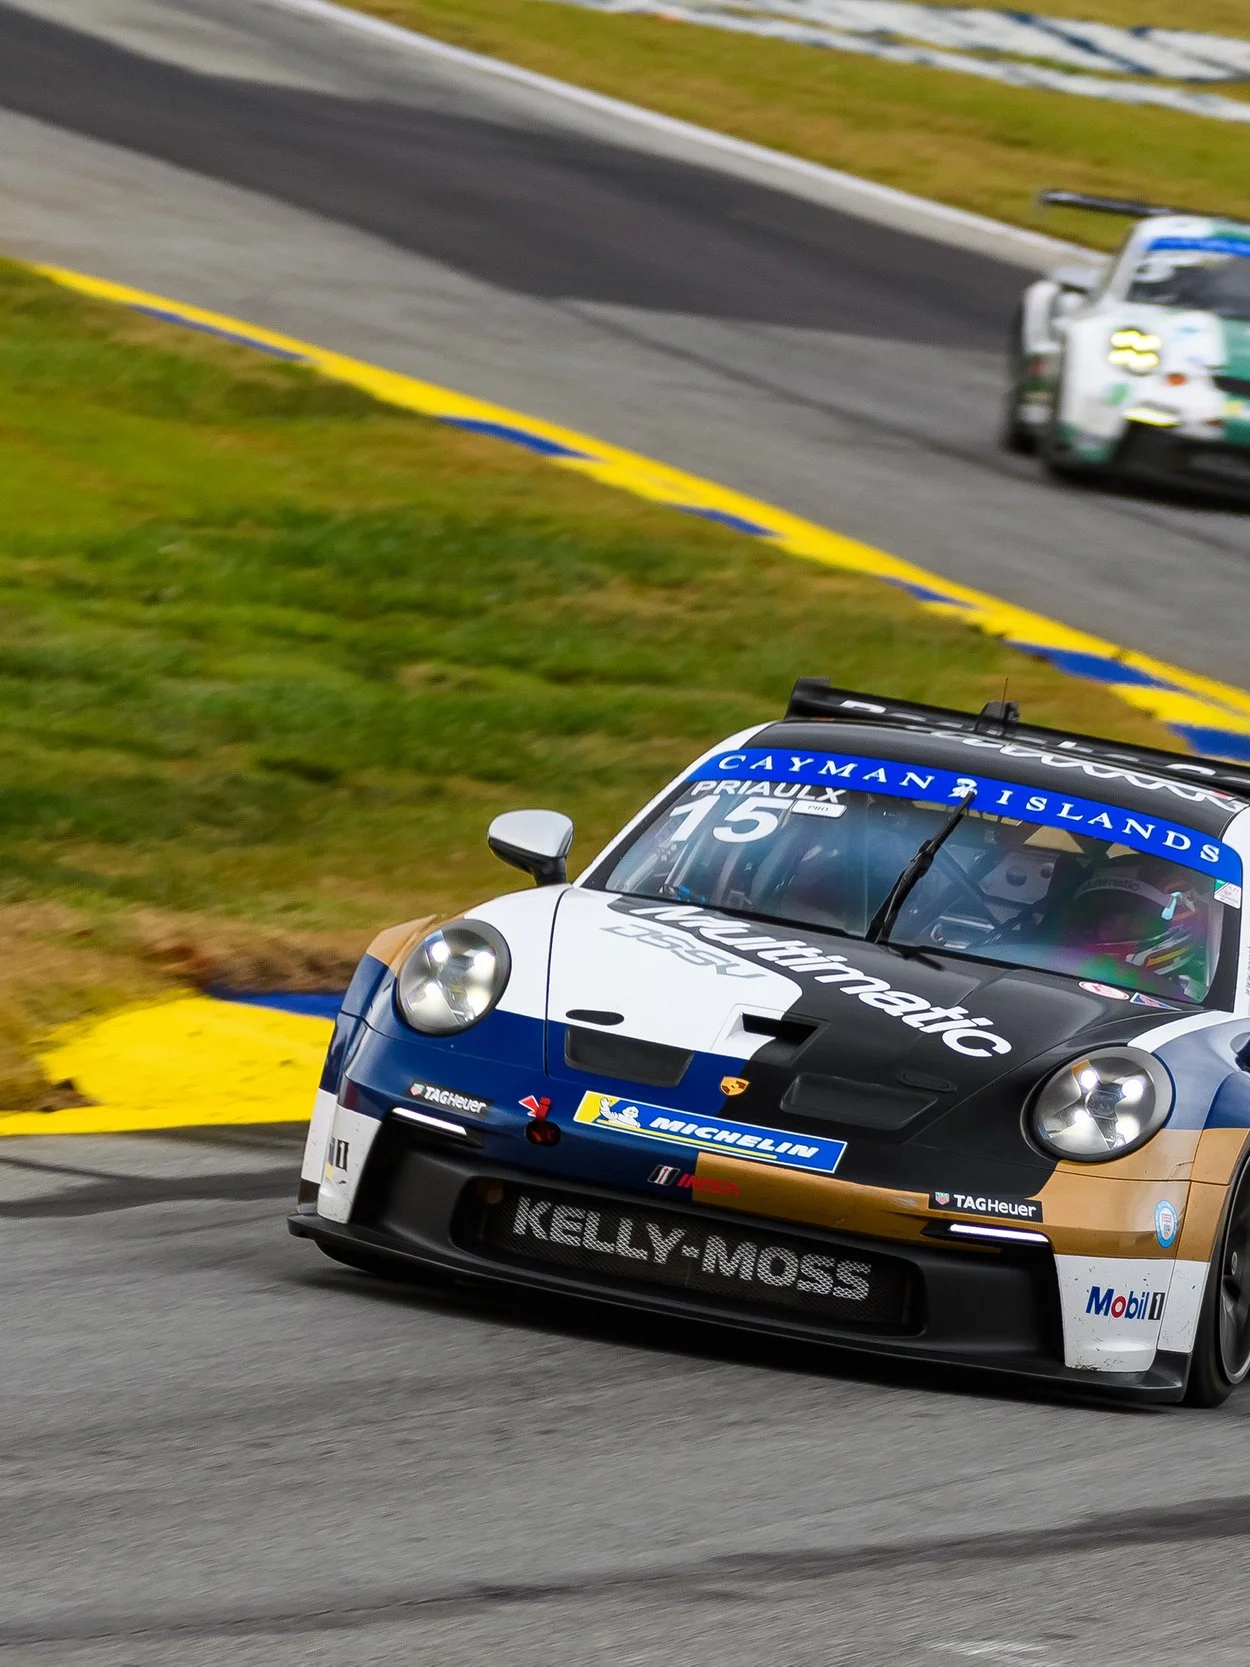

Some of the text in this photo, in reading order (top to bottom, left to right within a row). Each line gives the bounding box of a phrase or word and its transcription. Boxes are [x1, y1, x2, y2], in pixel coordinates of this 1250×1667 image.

[690, 780, 847, 805] PRIAULX
[718, 754, 935, 790] CAYMAN
[996, 789, 1220, 863] ISLANDS
[806, 805, 829, 813] PRO
[668, 794, 797, 843] 15
[629, 905, 1012, 1057] Multimatic
[649, 1116, 820, 1159] MICHELIN
[676, 1173, 741, 1198] IMSA
